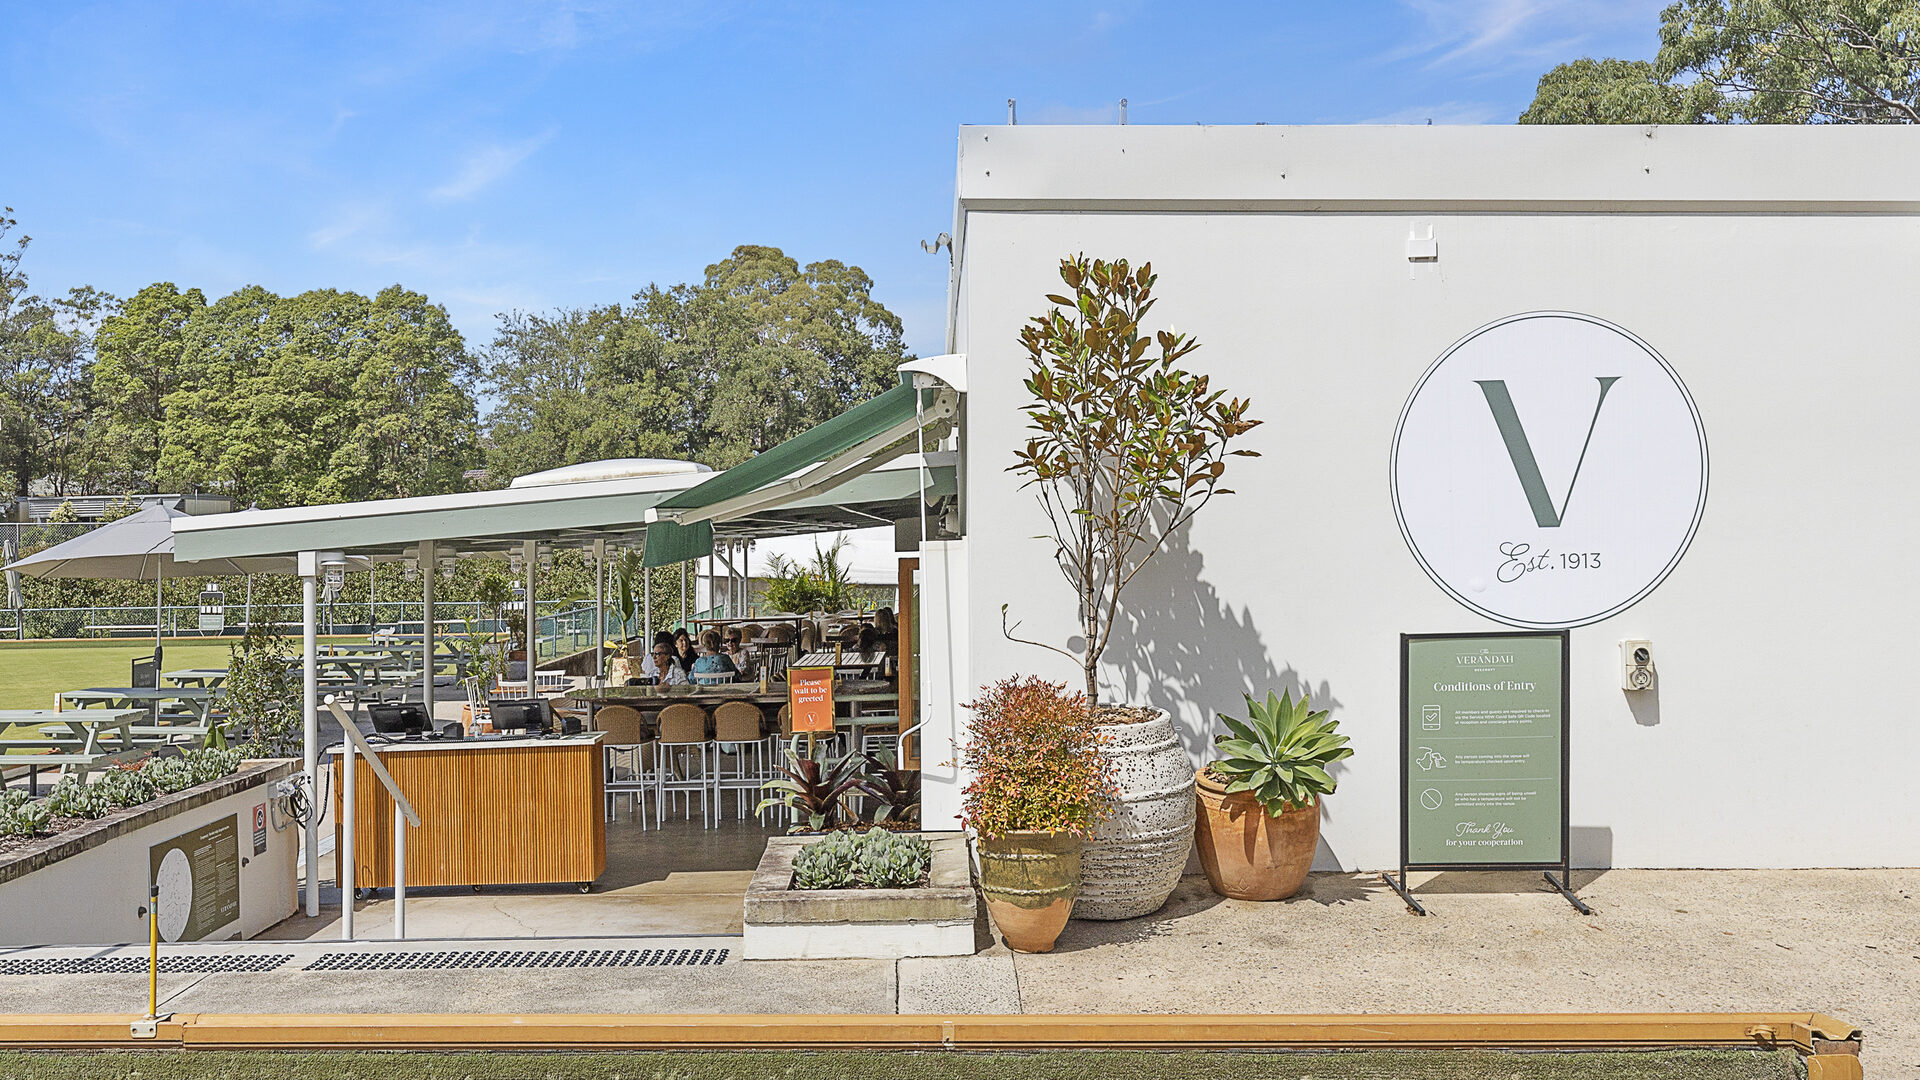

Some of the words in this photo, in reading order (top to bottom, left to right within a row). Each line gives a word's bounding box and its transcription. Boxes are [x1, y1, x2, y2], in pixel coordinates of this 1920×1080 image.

[1472, 376, 1622, 528] V
[1497, 541, 1554, 583] Est.
[1560, 552, 1601, 570] 1913
[1456, 655, 1514, 664] VERANDAH
[1434, 681, 1491, 692] Conditions
[1494, 681, 1504, 690] of
[1507, 681, 1536, 692] Entry
[798, 695, 824, 703] greeted
[1456, 822, 1491, 836] Thank
[1492, 822, 1514, 839] You
